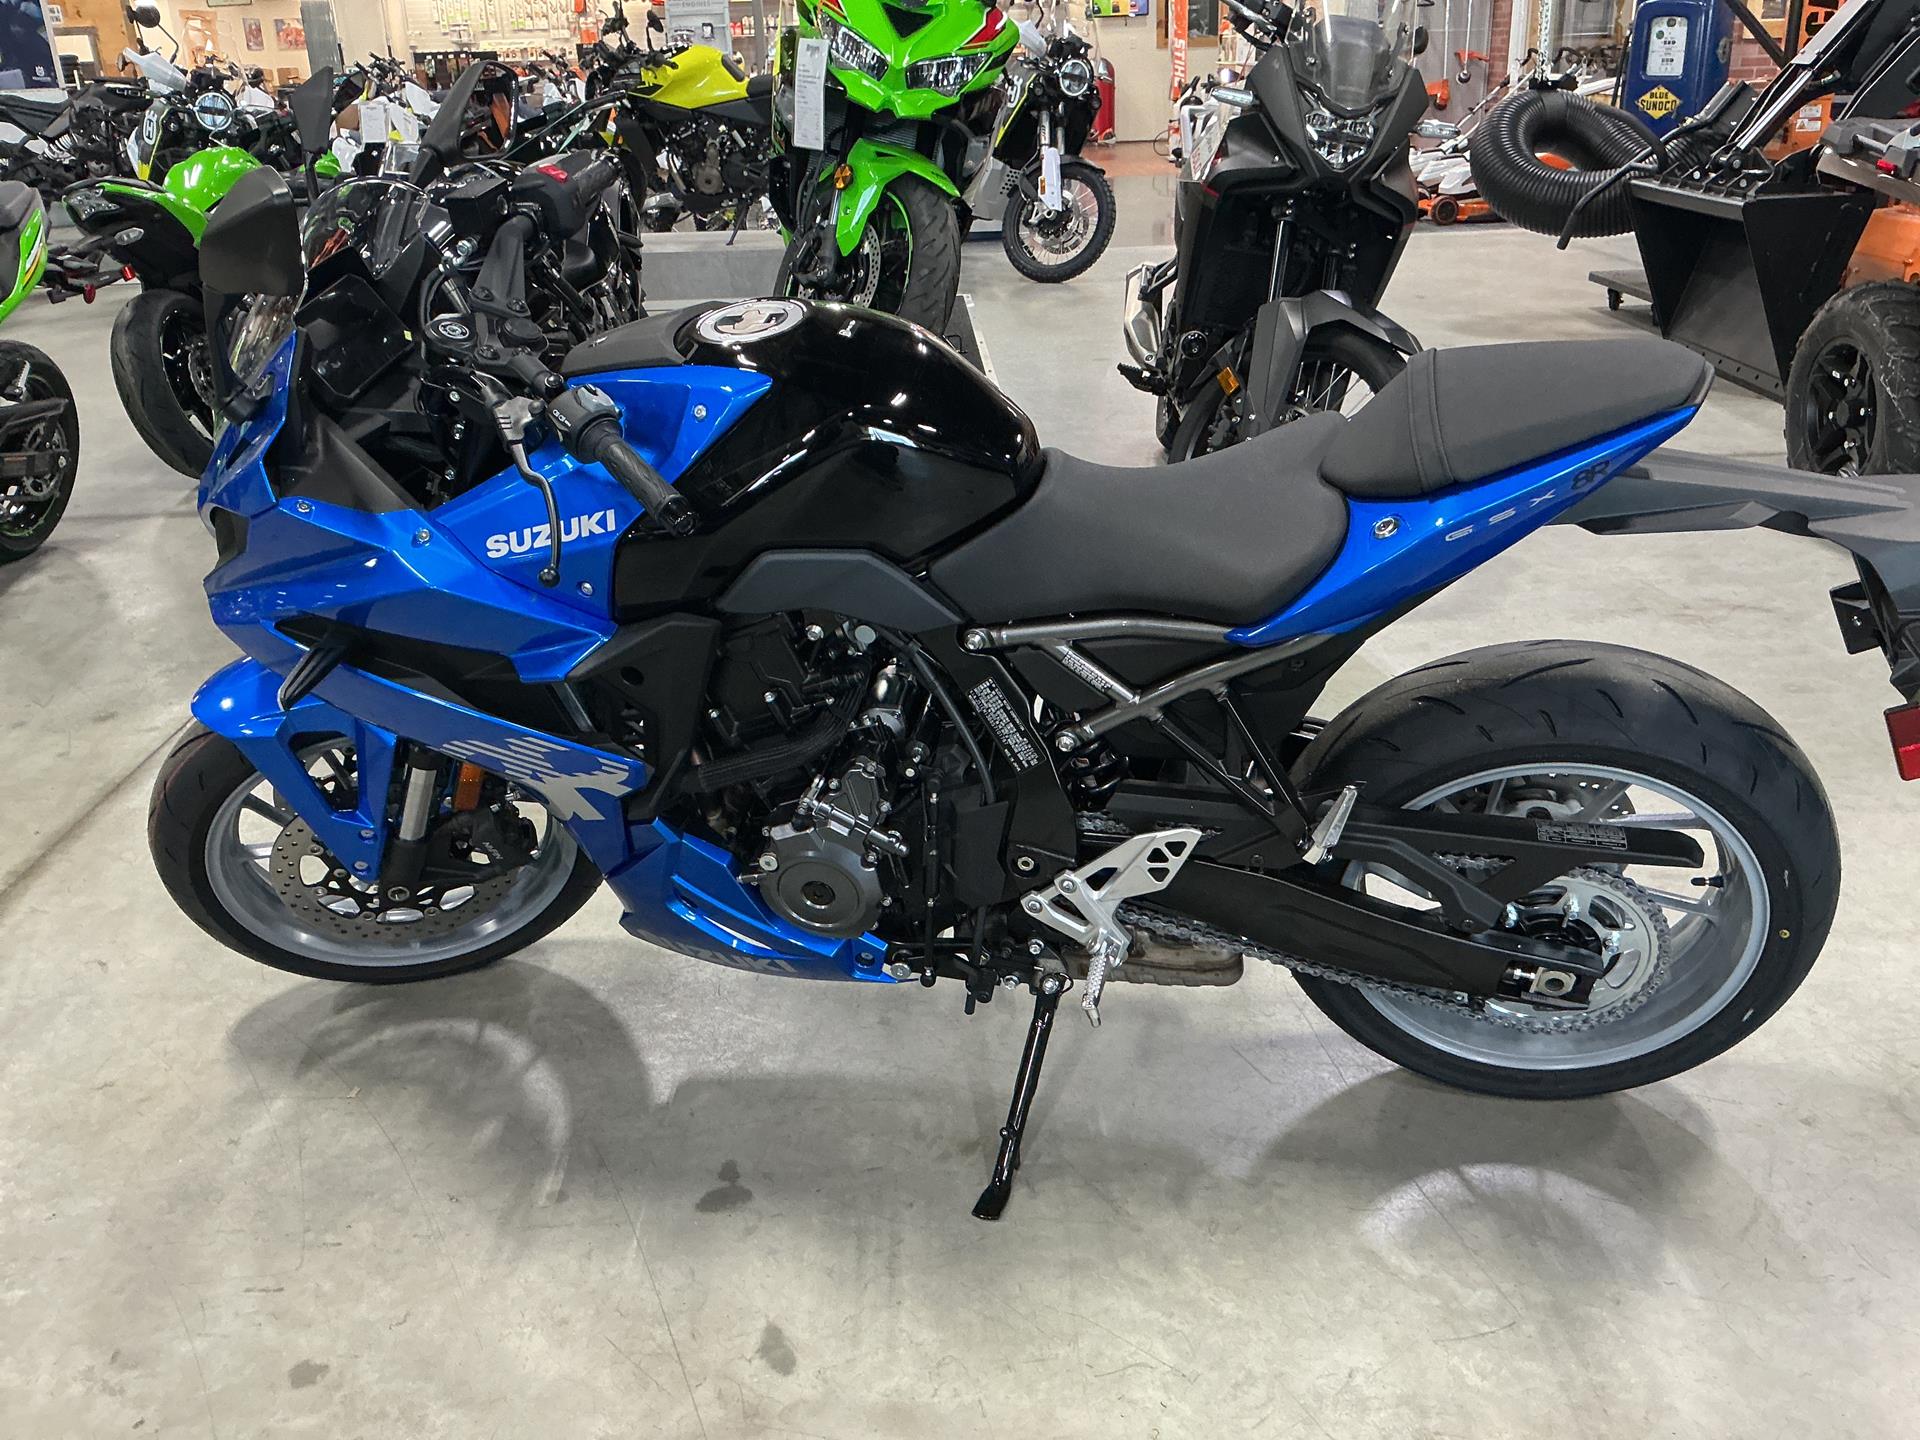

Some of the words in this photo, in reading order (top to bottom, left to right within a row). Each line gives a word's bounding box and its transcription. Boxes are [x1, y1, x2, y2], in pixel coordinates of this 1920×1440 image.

[1649, 91, 1669, 100] BLUE
[1640, 99, 1677, 111] SUNOCO
[485, 508, 616, 559] SUZUKI
